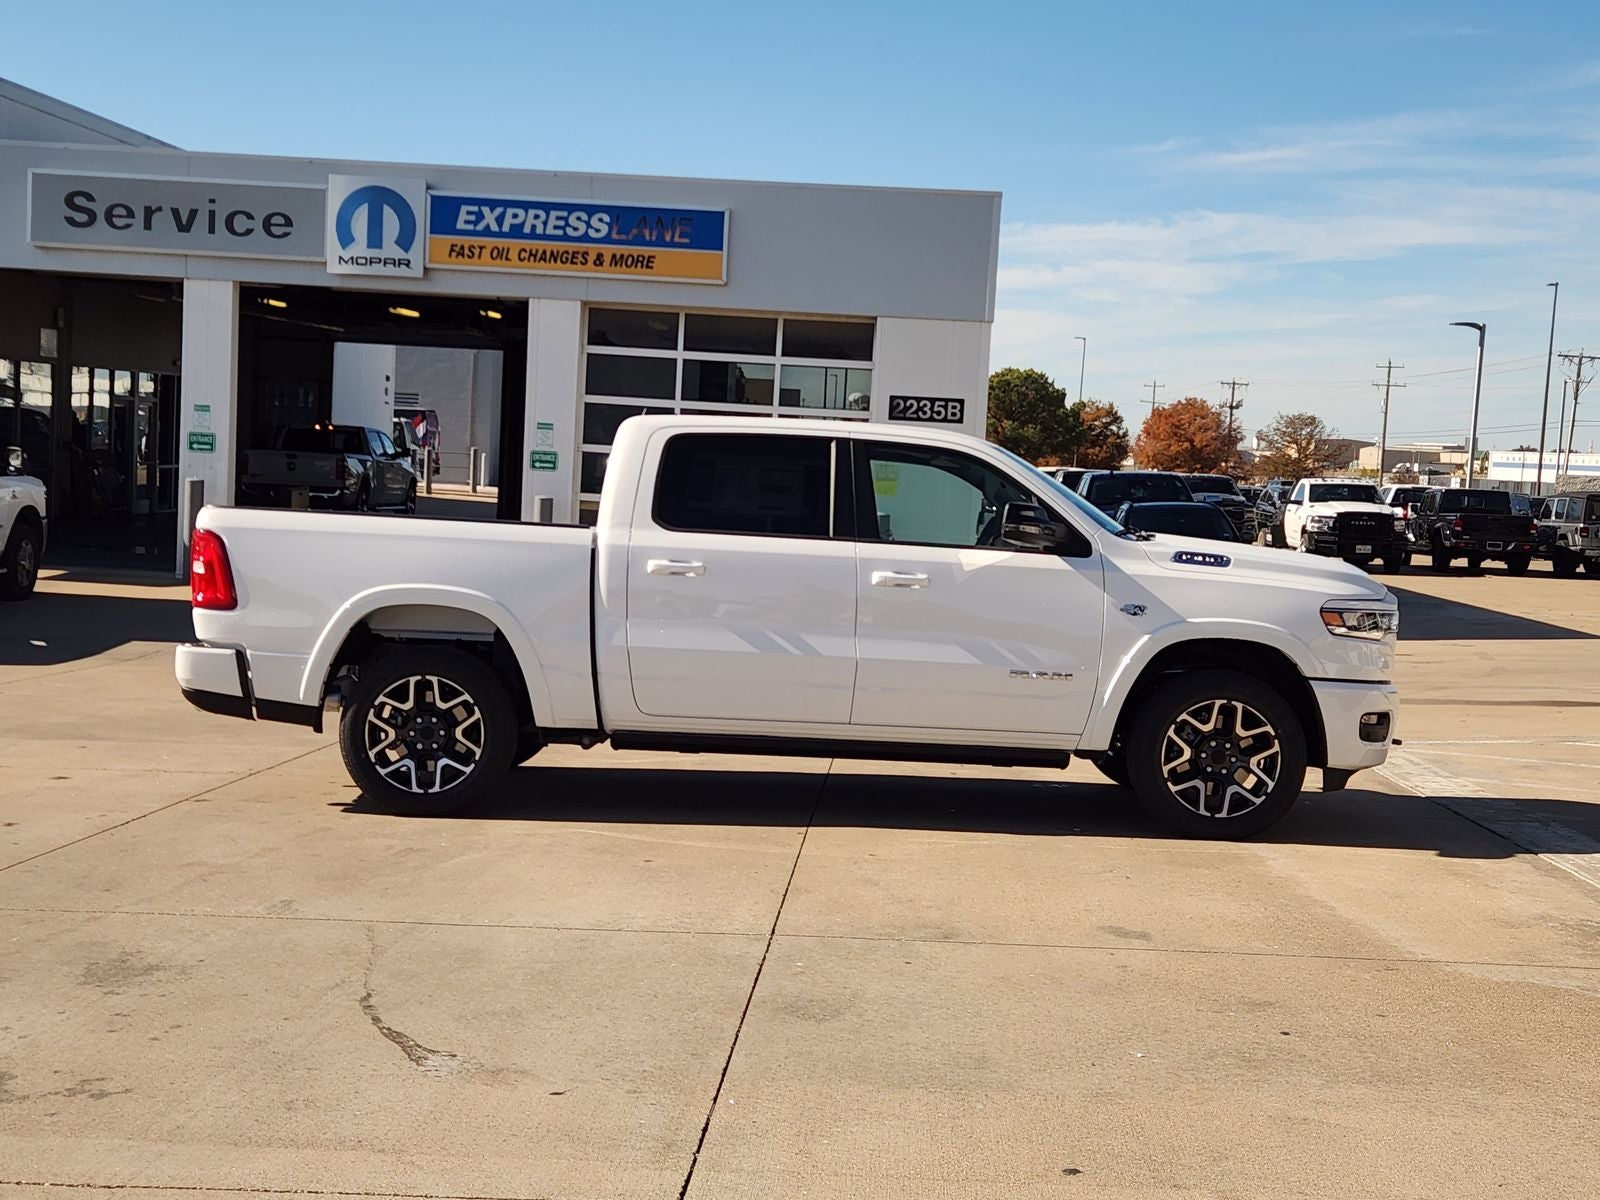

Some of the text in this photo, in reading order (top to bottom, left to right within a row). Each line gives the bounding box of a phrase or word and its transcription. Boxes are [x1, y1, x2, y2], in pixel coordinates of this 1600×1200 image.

[63, 190, 294, 239] Service
[338, 255, 413, 270] MOPAR
[448, 243, 656, 270] FAST OIL CHANGES & MORE
[891, 399, 961, 420] 2235B
